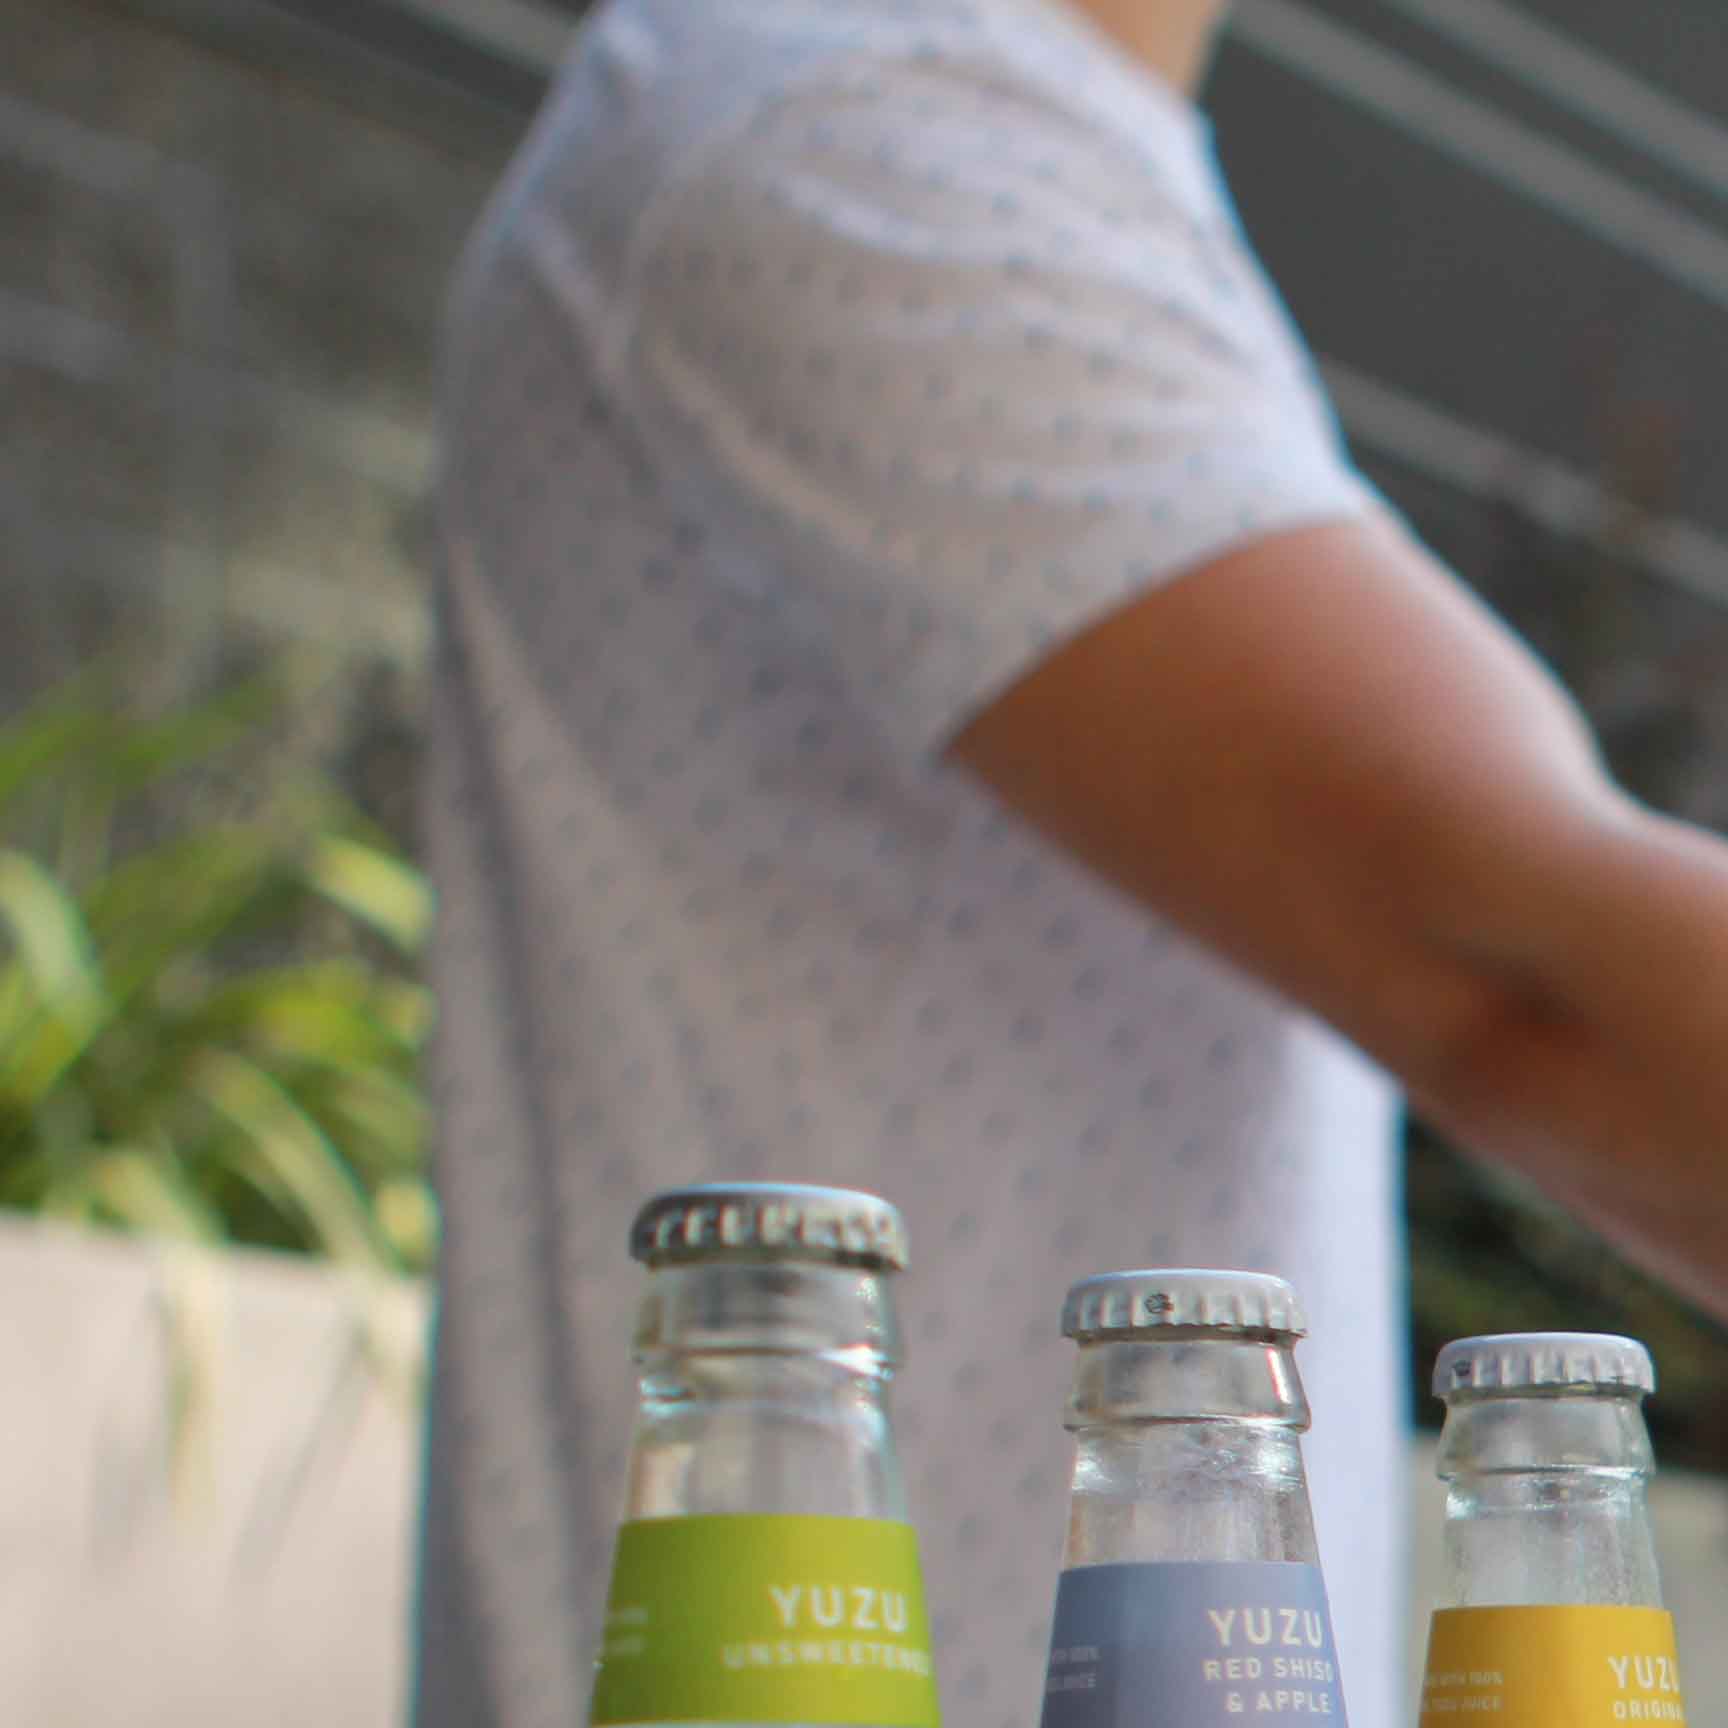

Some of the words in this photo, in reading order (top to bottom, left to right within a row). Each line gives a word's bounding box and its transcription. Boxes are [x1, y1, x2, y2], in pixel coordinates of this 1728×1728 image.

[770, 1586, 908, 1633] YUZU
[1208, 1608, 1324, 1648] YUZU
[1204, 1658, 1262, 1681] RED
[1225, 1691, 1245, 1713] &
[1256, 1690, 1332, 1714] APPLE
